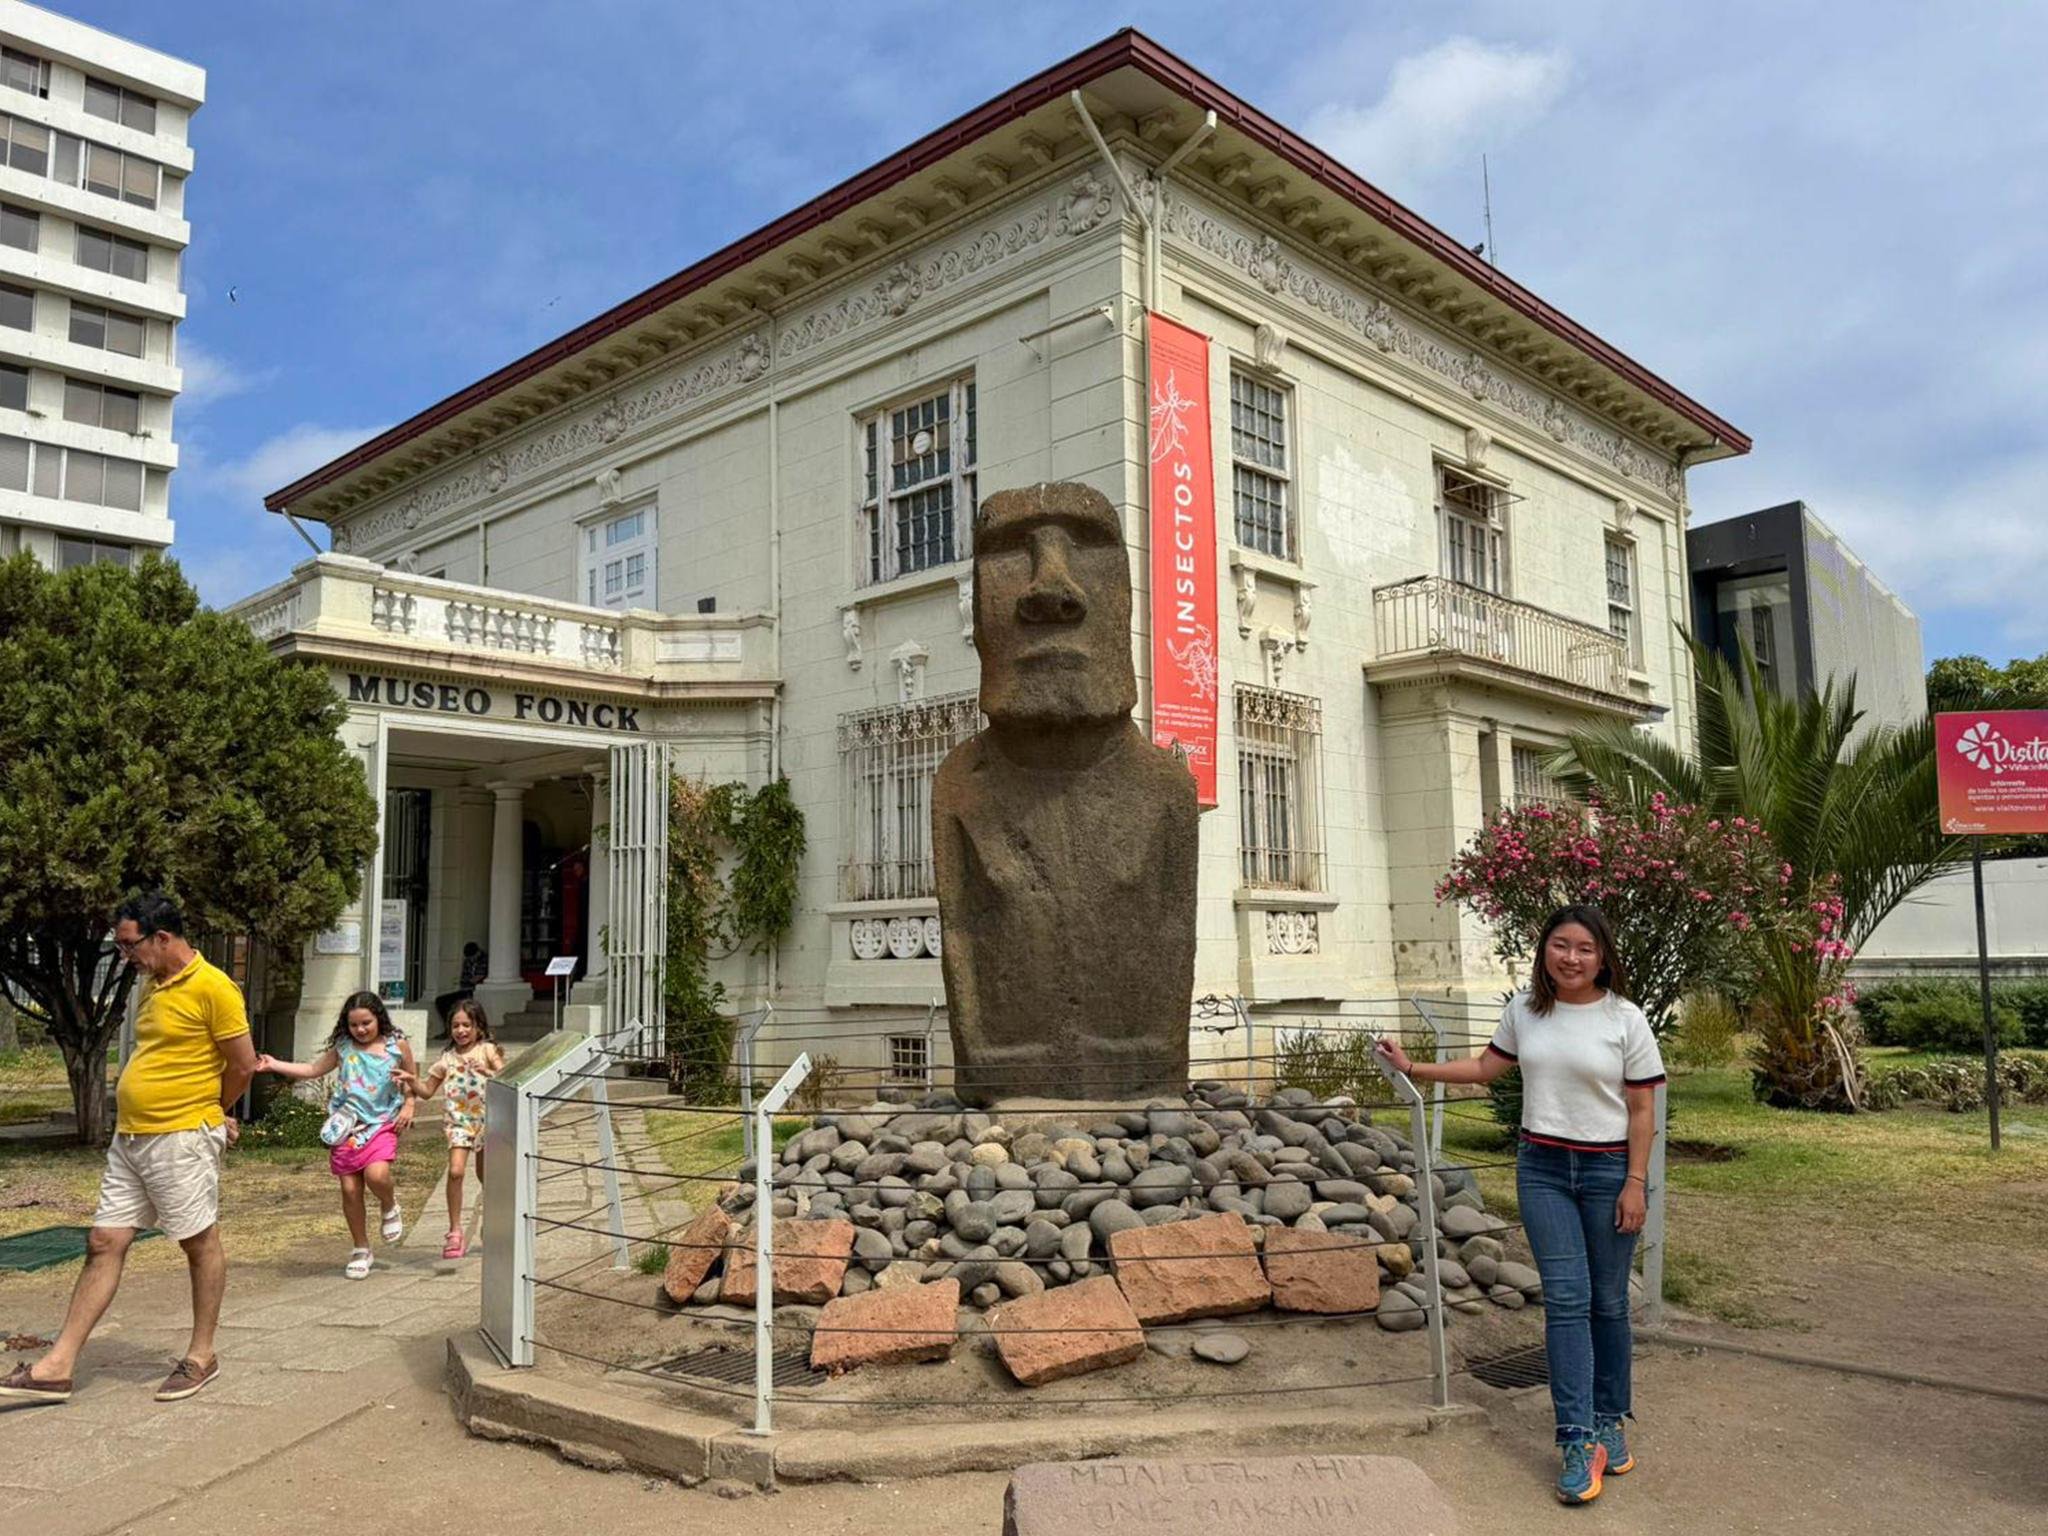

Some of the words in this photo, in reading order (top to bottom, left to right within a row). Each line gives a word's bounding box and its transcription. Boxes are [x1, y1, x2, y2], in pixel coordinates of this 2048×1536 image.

[1174, 462, 1196, 634] INSECTOS
[347, 674, 491, 715] MUSEO
[514, 693, 640, 731] FONCK
[1982, 736, 2048, 763] Visita
